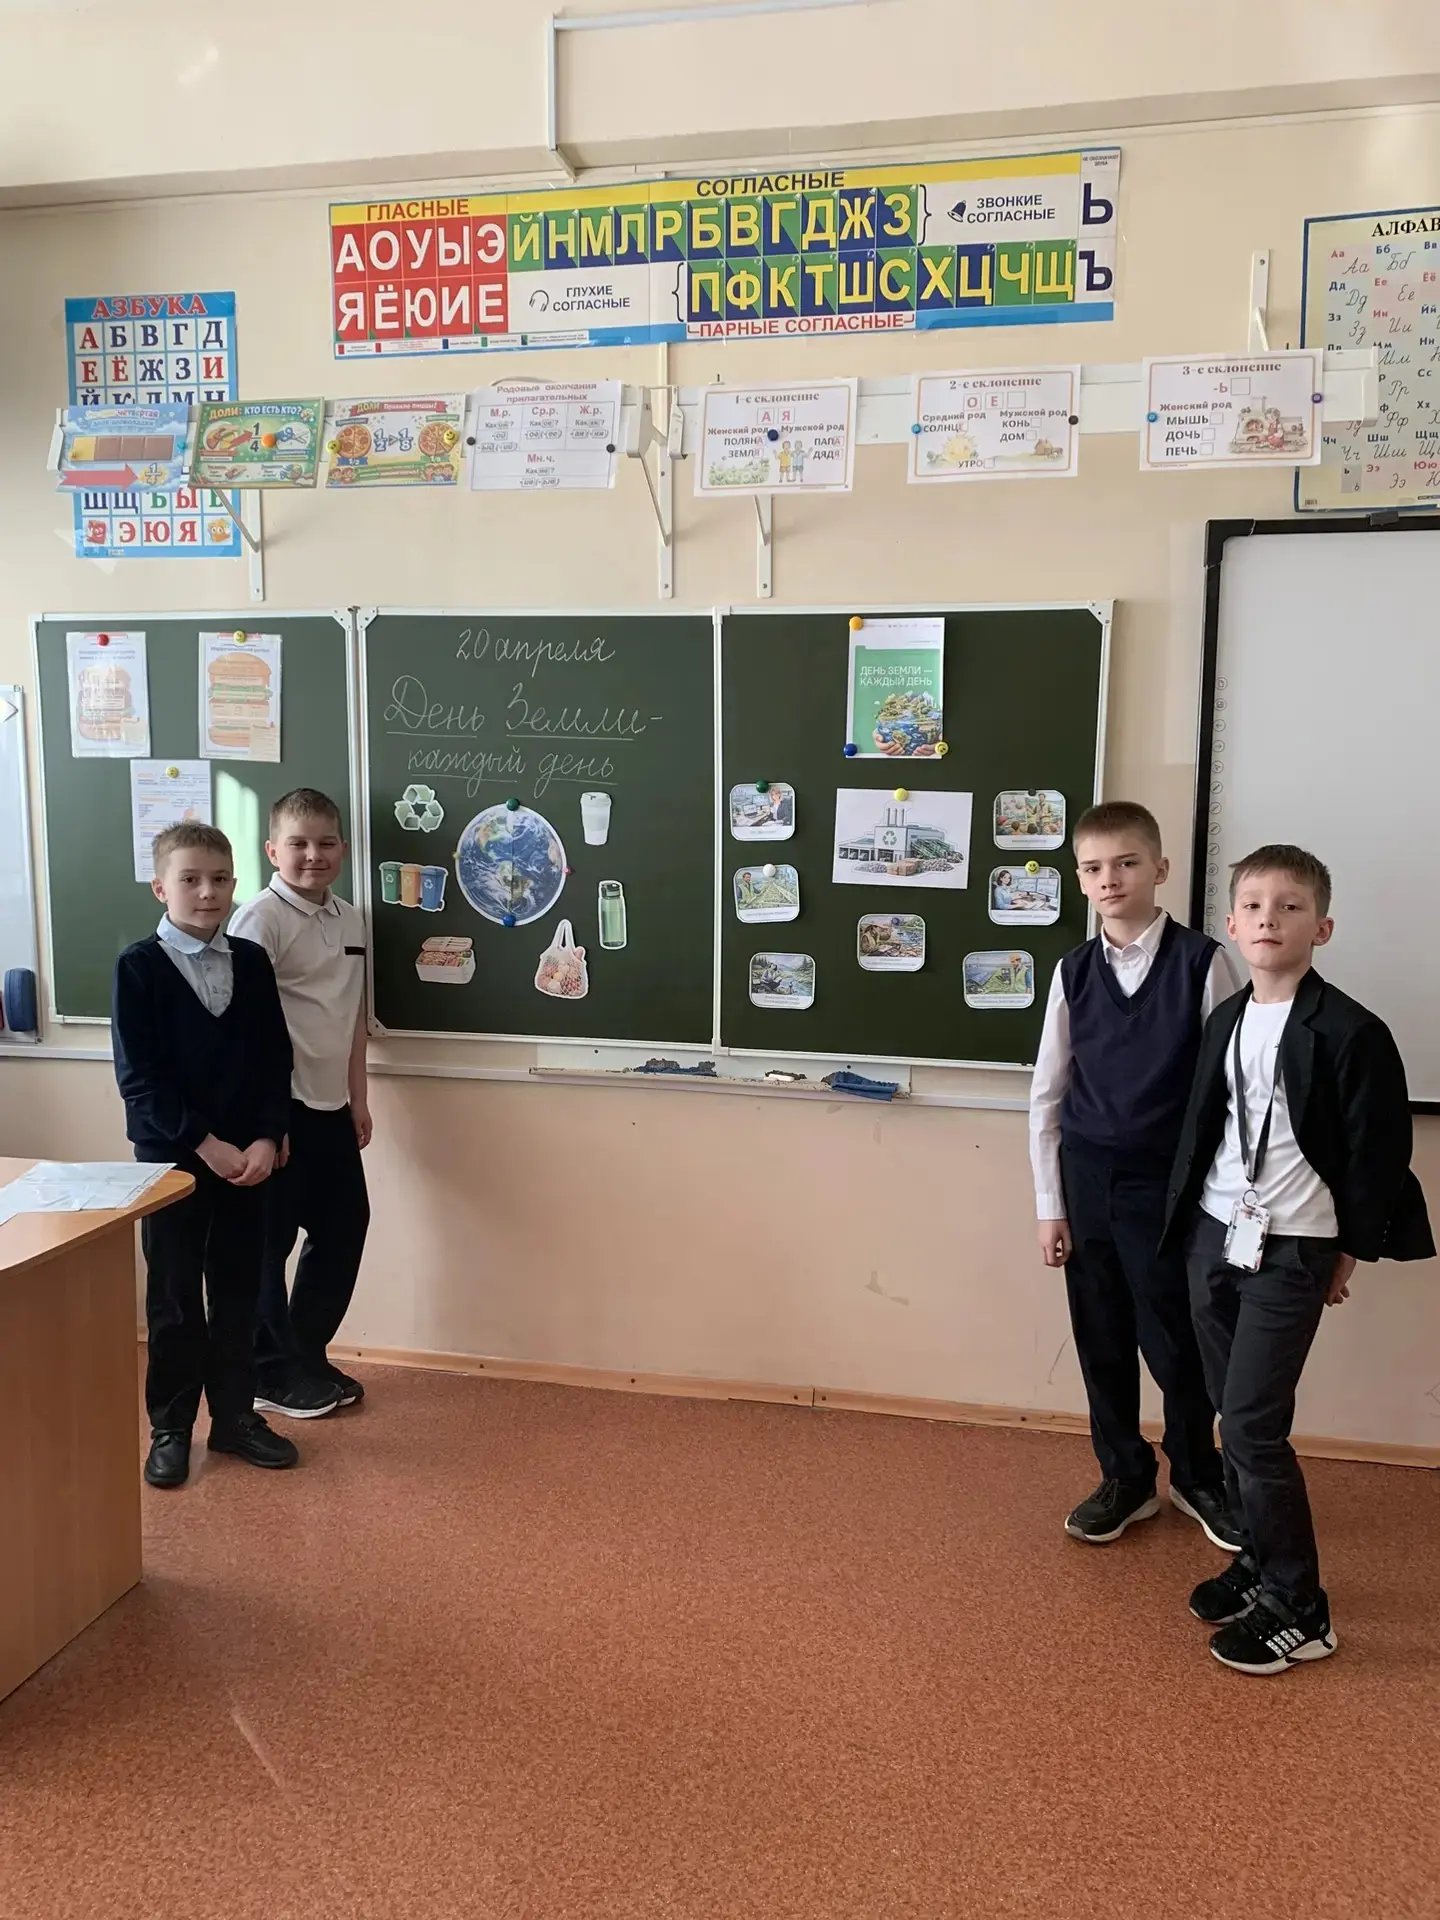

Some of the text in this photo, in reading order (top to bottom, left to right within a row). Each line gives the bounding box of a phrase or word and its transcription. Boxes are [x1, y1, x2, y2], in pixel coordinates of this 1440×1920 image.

[696, 171, 845, 198] СОГЛАСНЫЕ
[977, 194, 1043, 208] ЗВОНКИЕ
[367, 199, 469, 221] ГЛАСНЫЕ
[966, 207, 1056, 224] СОГЛАСНЫЕ
[1376, 244, 1390, 254] Бб
[566, 284, 613, 298] ГЛУХИЕ
[1329, 281, 1346, 291] Дд
[92, 294, 208, 319] АЗБУКА
[552, 297, 630, 312] СОГЛАСНЫЕ
[700, 313, 904, 337] ПАРНЫЕ СОГЛАСНЫЕ
[80, 321, 223, 349] А Б В Г Д
[82, 355, 224, 383] Е Ё Ж З И
[497, 383, 597, 394] Родовые окончания
[506, 394, 588, 404] прилагательных
[1160, 401, 1232, 411] Женский род
[209, 405, 302, 420] ДОЛИ: КТО ЕСТЬ КТО?
[922, 412, 987, 422] Средний род
[1000, 409, 1068, 418] Мужской род
[1002, 420, 1030, 428] КОНЬ
[1166, 413, 1209, 426] МЫШЬ
[708, 425, 769, 435] Женский род
[781, 423, 844, 433] Мужской род
[724, 436, 763, 446] ПОЛЯНА
[814, 437, 841, 446] ПАПА
[1000, 433, 1025, 443] ДОМ
[1165, 430, 1200, 442] ДОЧЬ
[728, 449, 761, 458] ЗЕМЛЯ
[813, 450, 840, 460] ДЯДЯ
[1166, 446, 1198, 457] ПЕЧЬ
[958, 459, 984, 469] УТРО
[119, 521, 197, 543] Э Ю Я
[456, 628, 616, 678] 20 апреля
[860, 666, 921, 676] ДЕНЬ ЗЕМЛИ
[860, 675, 933, 687] КАЖДЫЙ ДЕНЬ
[383, 675, 486, 731] День
[408, 745, 615, 799] каждый день
